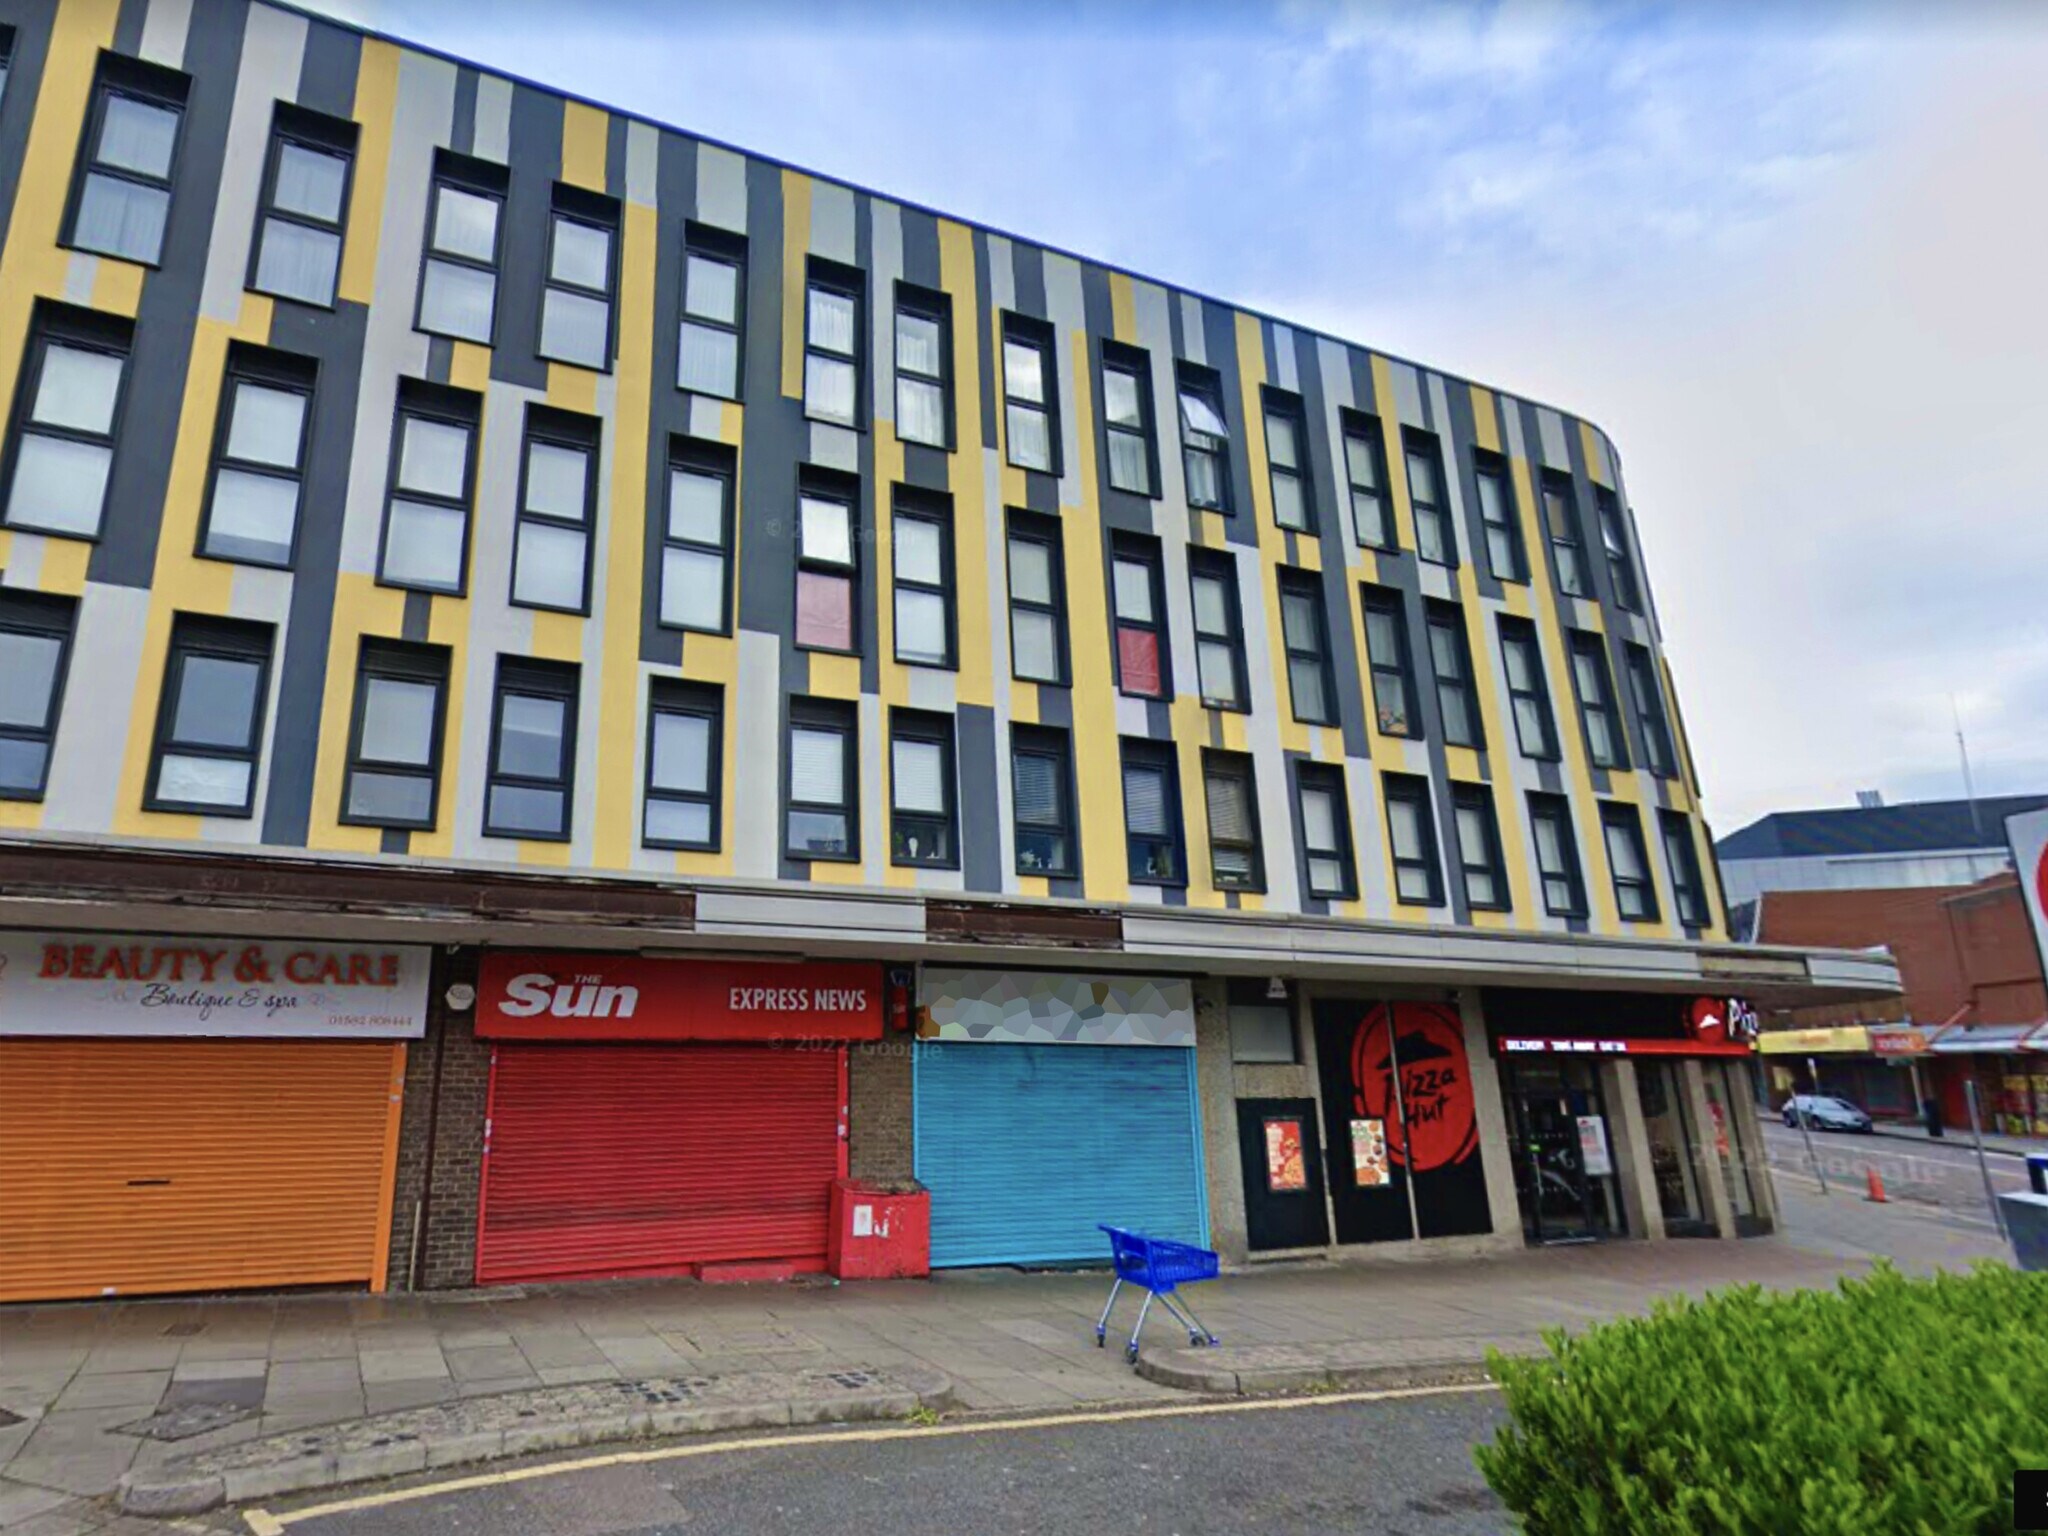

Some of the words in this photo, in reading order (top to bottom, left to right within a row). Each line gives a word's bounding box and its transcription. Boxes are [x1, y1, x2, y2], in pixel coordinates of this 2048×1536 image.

[38, 943, 229, 981] BEAUTY
[233, 945, 275, 983] &
[284, 951, 400, 987] CARE
[574, 974, 603, 984] THE
[498, 973, 639, 1018] Sun
[729, 987, 808, 1010] EXPRESS
[814, 989, 867, 1011] NEWS
